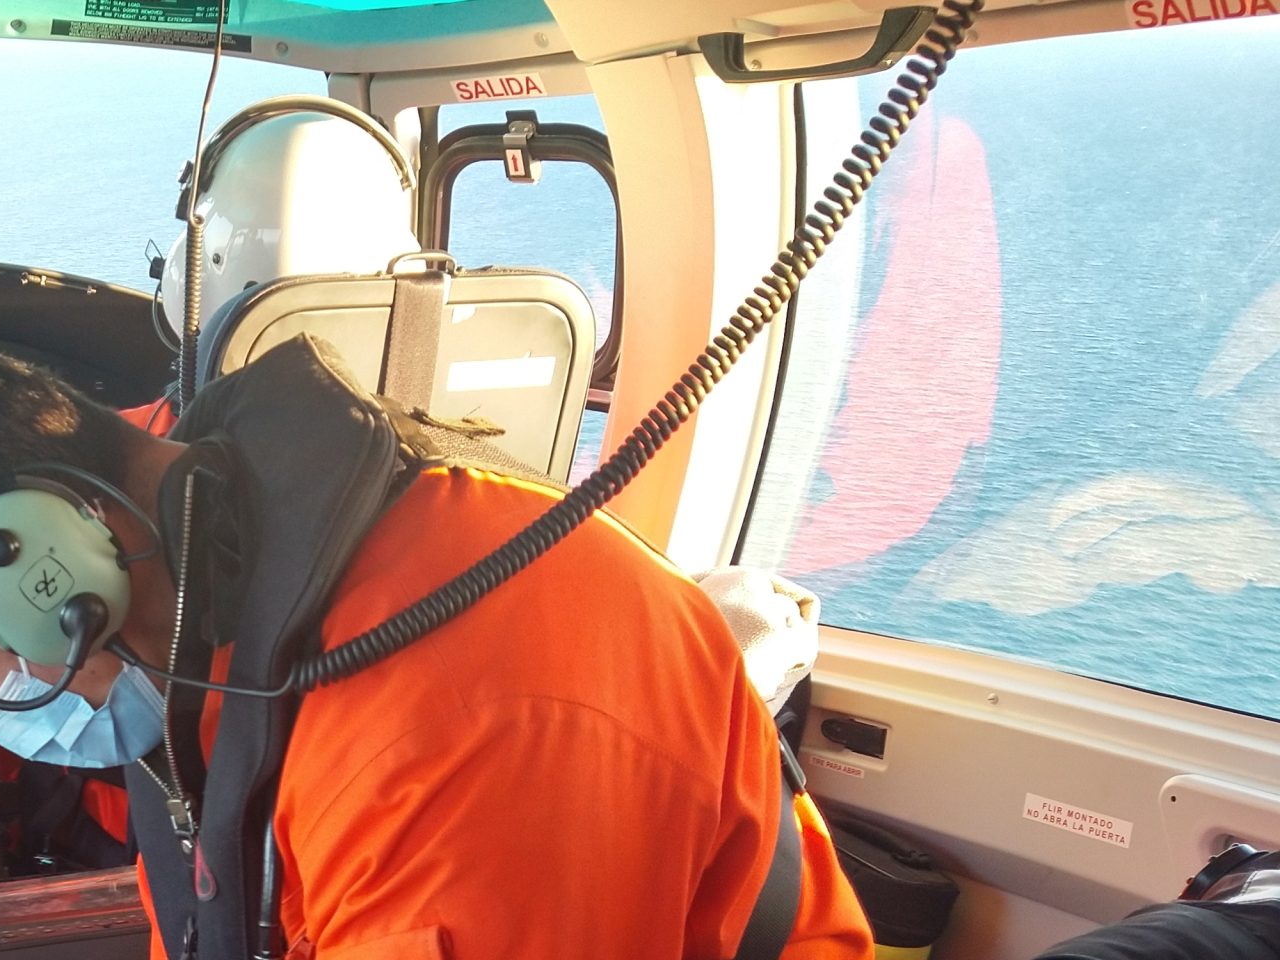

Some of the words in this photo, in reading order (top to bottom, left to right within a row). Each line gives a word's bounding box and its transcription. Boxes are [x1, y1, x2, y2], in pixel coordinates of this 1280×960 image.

[1132, 0, 1279, 29] SALIDA
[456, 76, 543, 100] SALIDA
[1027, 808, 1040, 818] NO
[1043, 813, 1068, 827] ABRA
[1072, 821, 1084, 831] LA
[1089, 826, 1126, 844] PUERTA
[1042, 802, 1063, 815] FLIR
[1067, 809, 1114, 829] MONTADO
